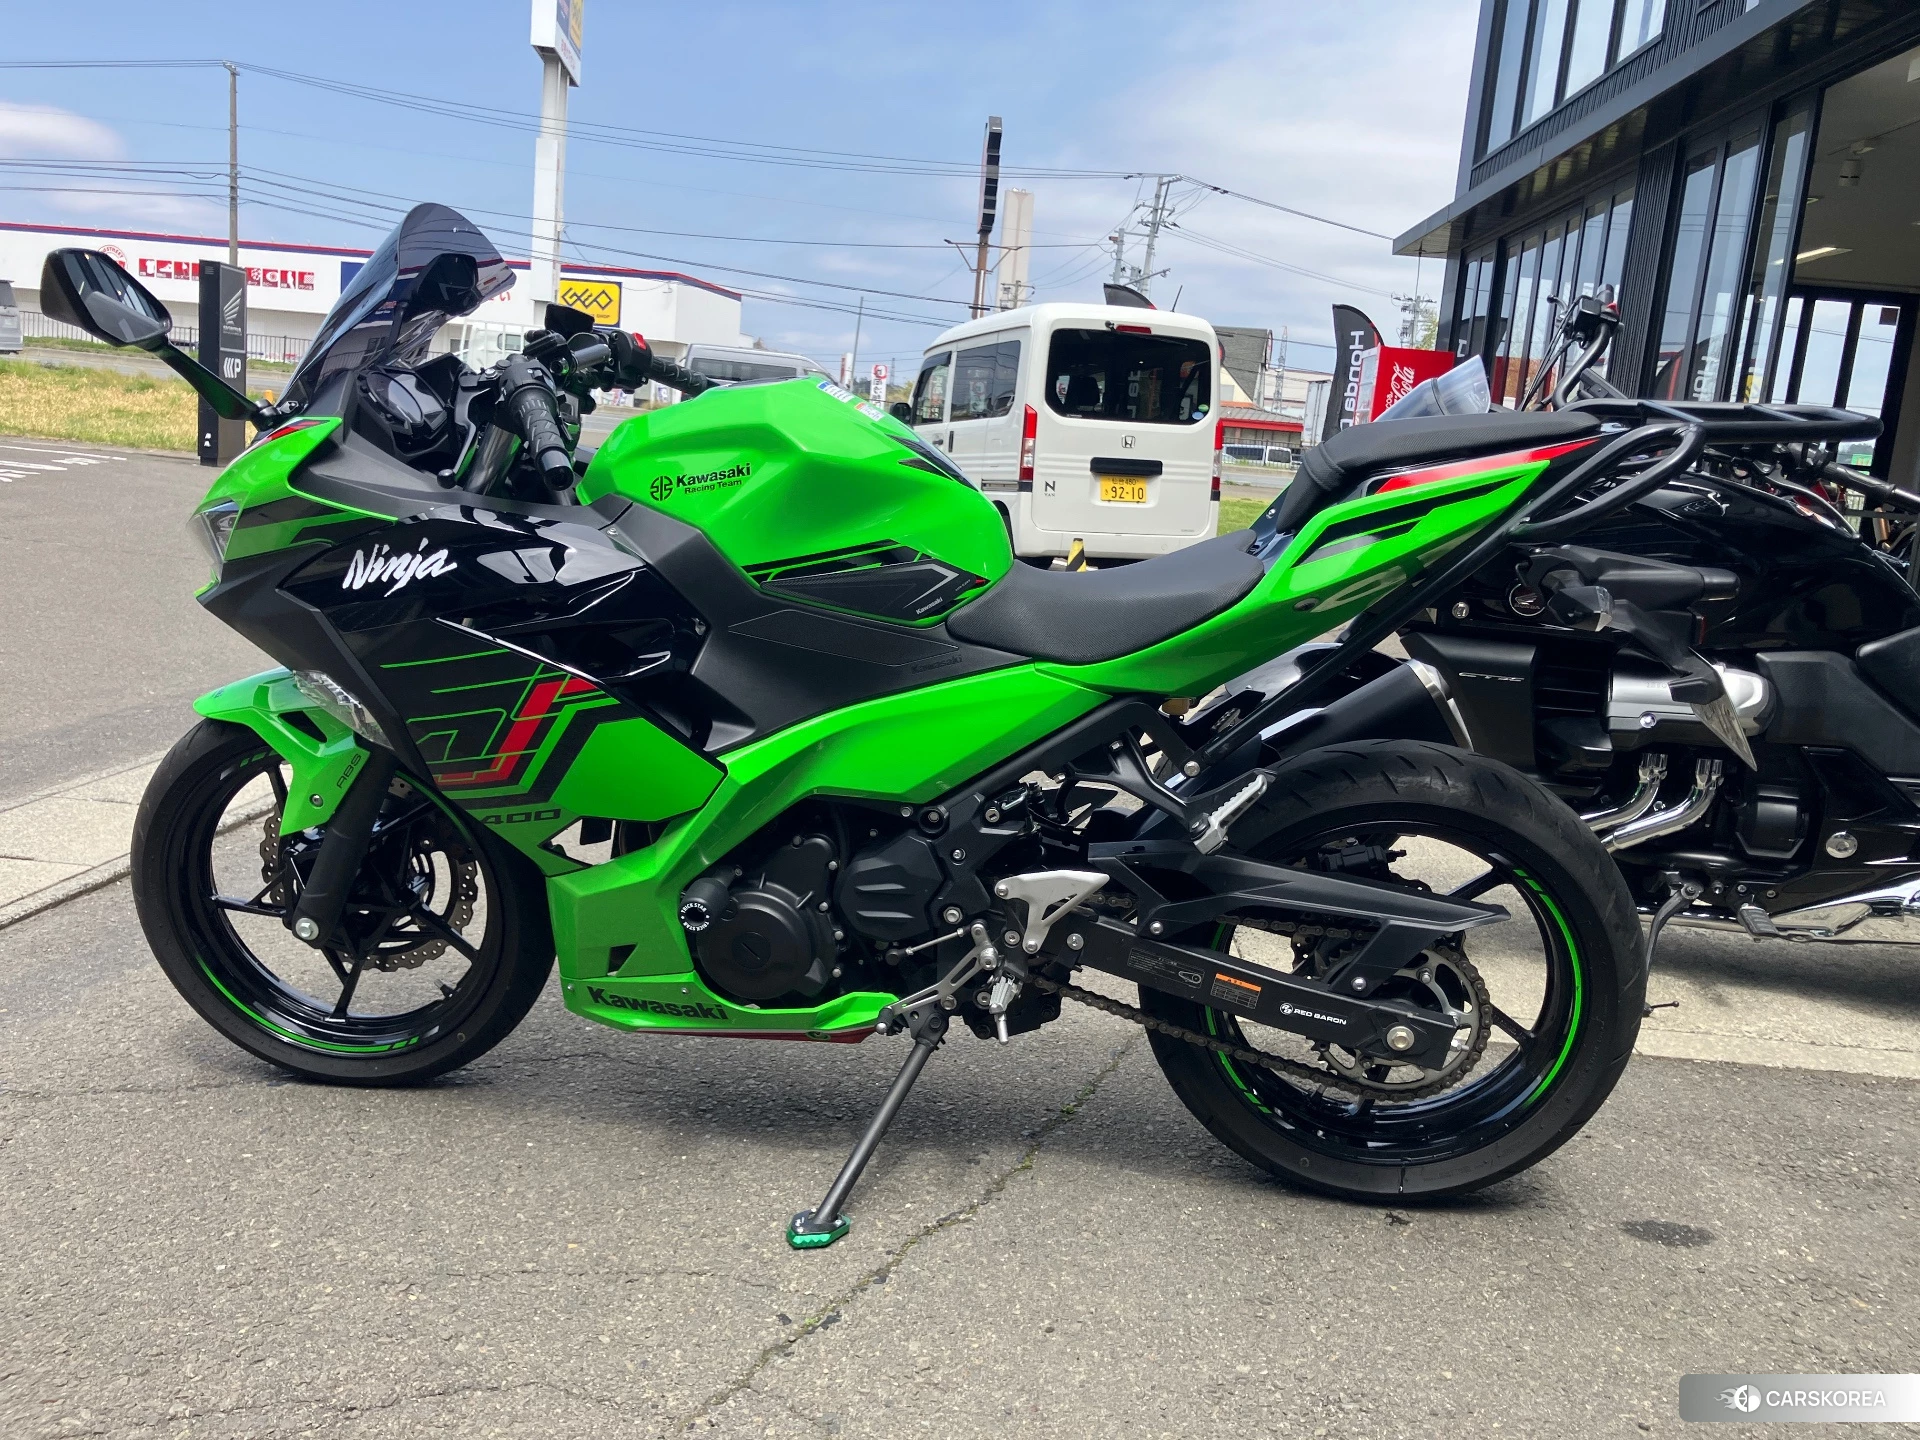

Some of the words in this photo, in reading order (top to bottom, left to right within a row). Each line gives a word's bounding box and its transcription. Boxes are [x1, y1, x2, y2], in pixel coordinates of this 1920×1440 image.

[561, 287, 614, 311] GEO
[676, 463, 751, 488] Kawasaki
[684, 484, 716, 494] Racing
[717, 480, 742, 490] Team
[1044, 480, 1056, 493] N
[1111, 486, 1144, 500] 92-10
[342, 537, 458, 598] Ninja
[915, 596, 944, 615] Kawasaki
[336, 753, 362, 789] ABS
[482, 808, 562, 825] 400
[587, 986, 729, 1020] Kawasaki
[1294, 1008, 1313, 1018] RED
[1313, 1013, 1347, 1026] BARON
